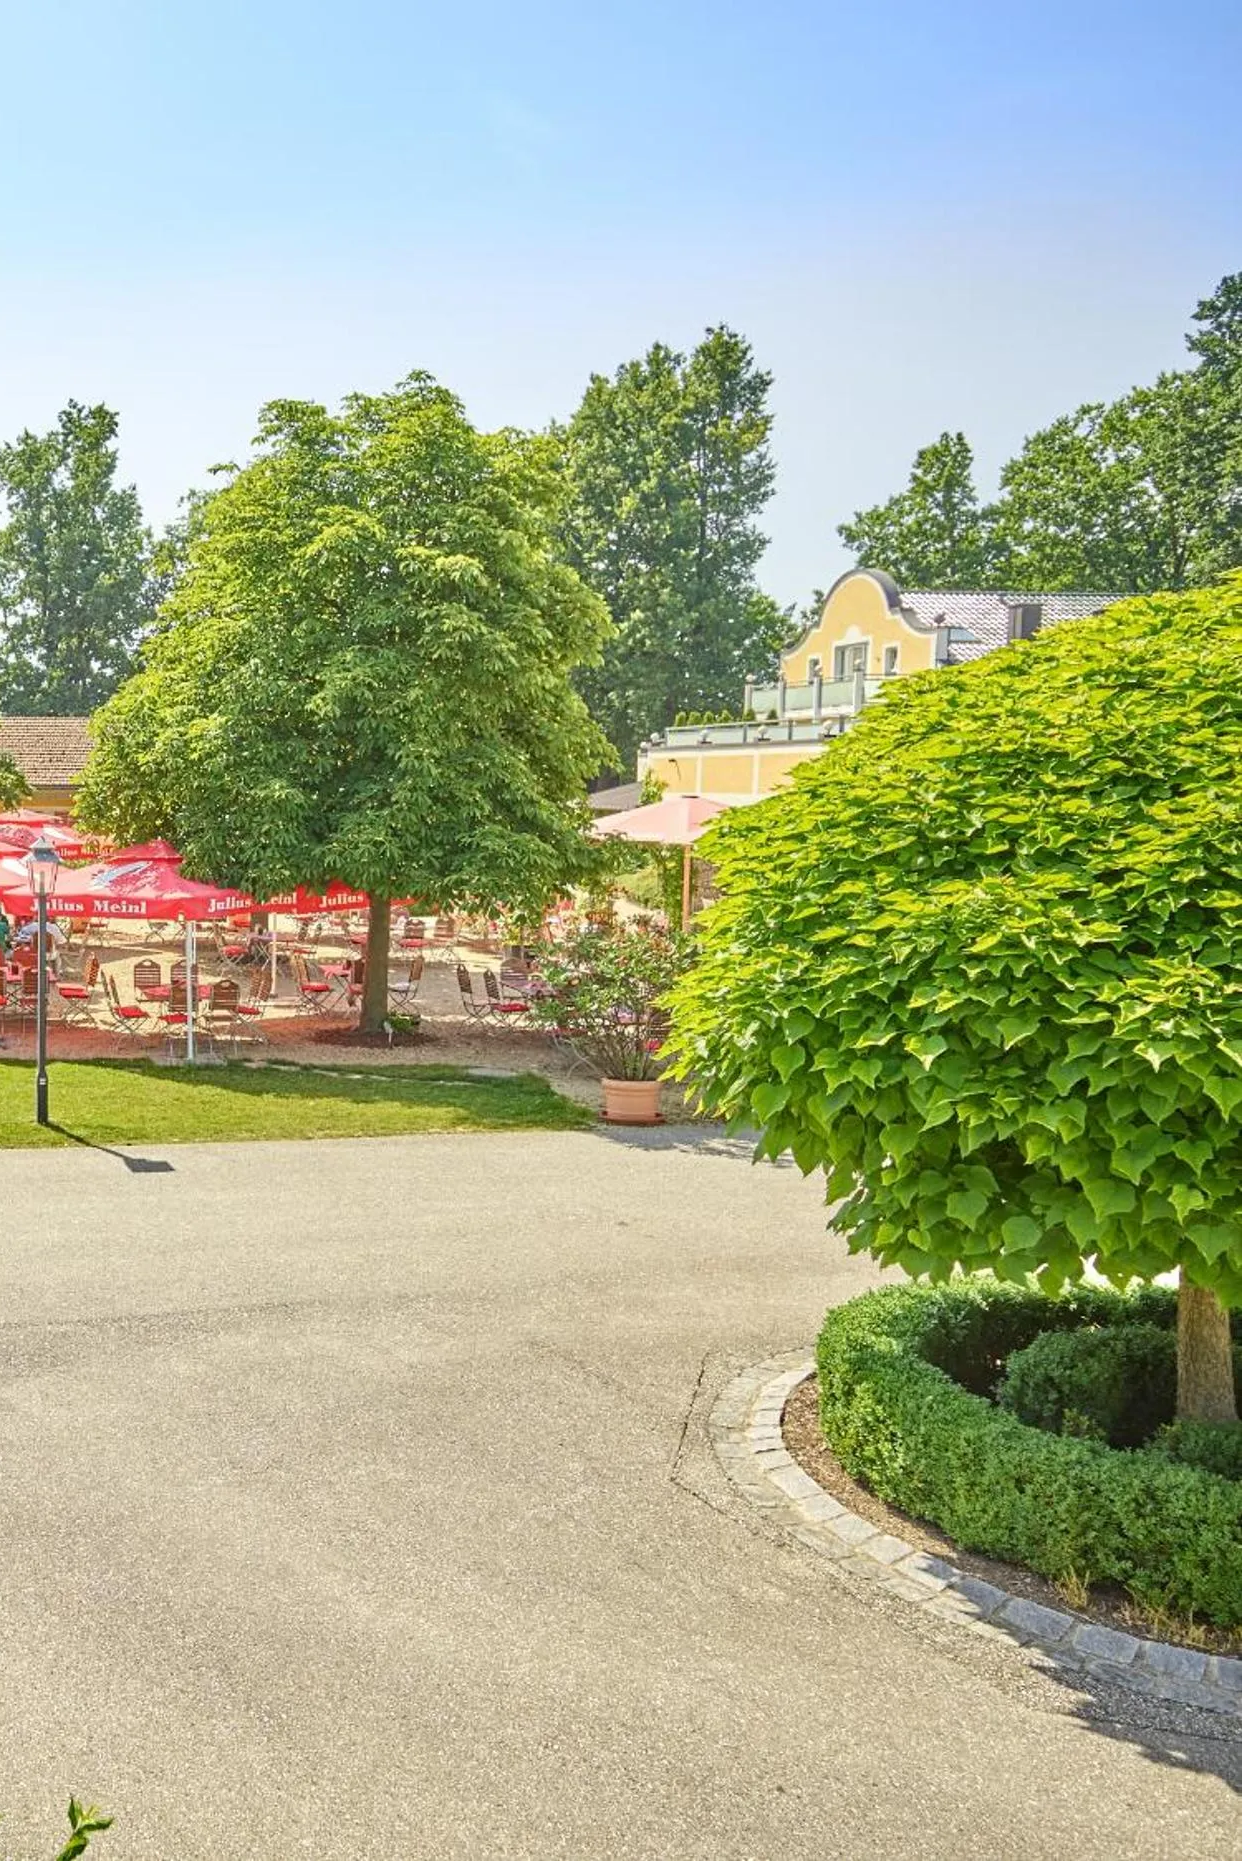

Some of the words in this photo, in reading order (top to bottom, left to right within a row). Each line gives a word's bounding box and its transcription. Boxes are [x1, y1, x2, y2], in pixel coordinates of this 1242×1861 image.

[93, 900, 147, 914] Meinl
[208, 896, 252, 912] Julius
[261, 892, 297, 906] einl
[319, 893, 364, 908] Julius
